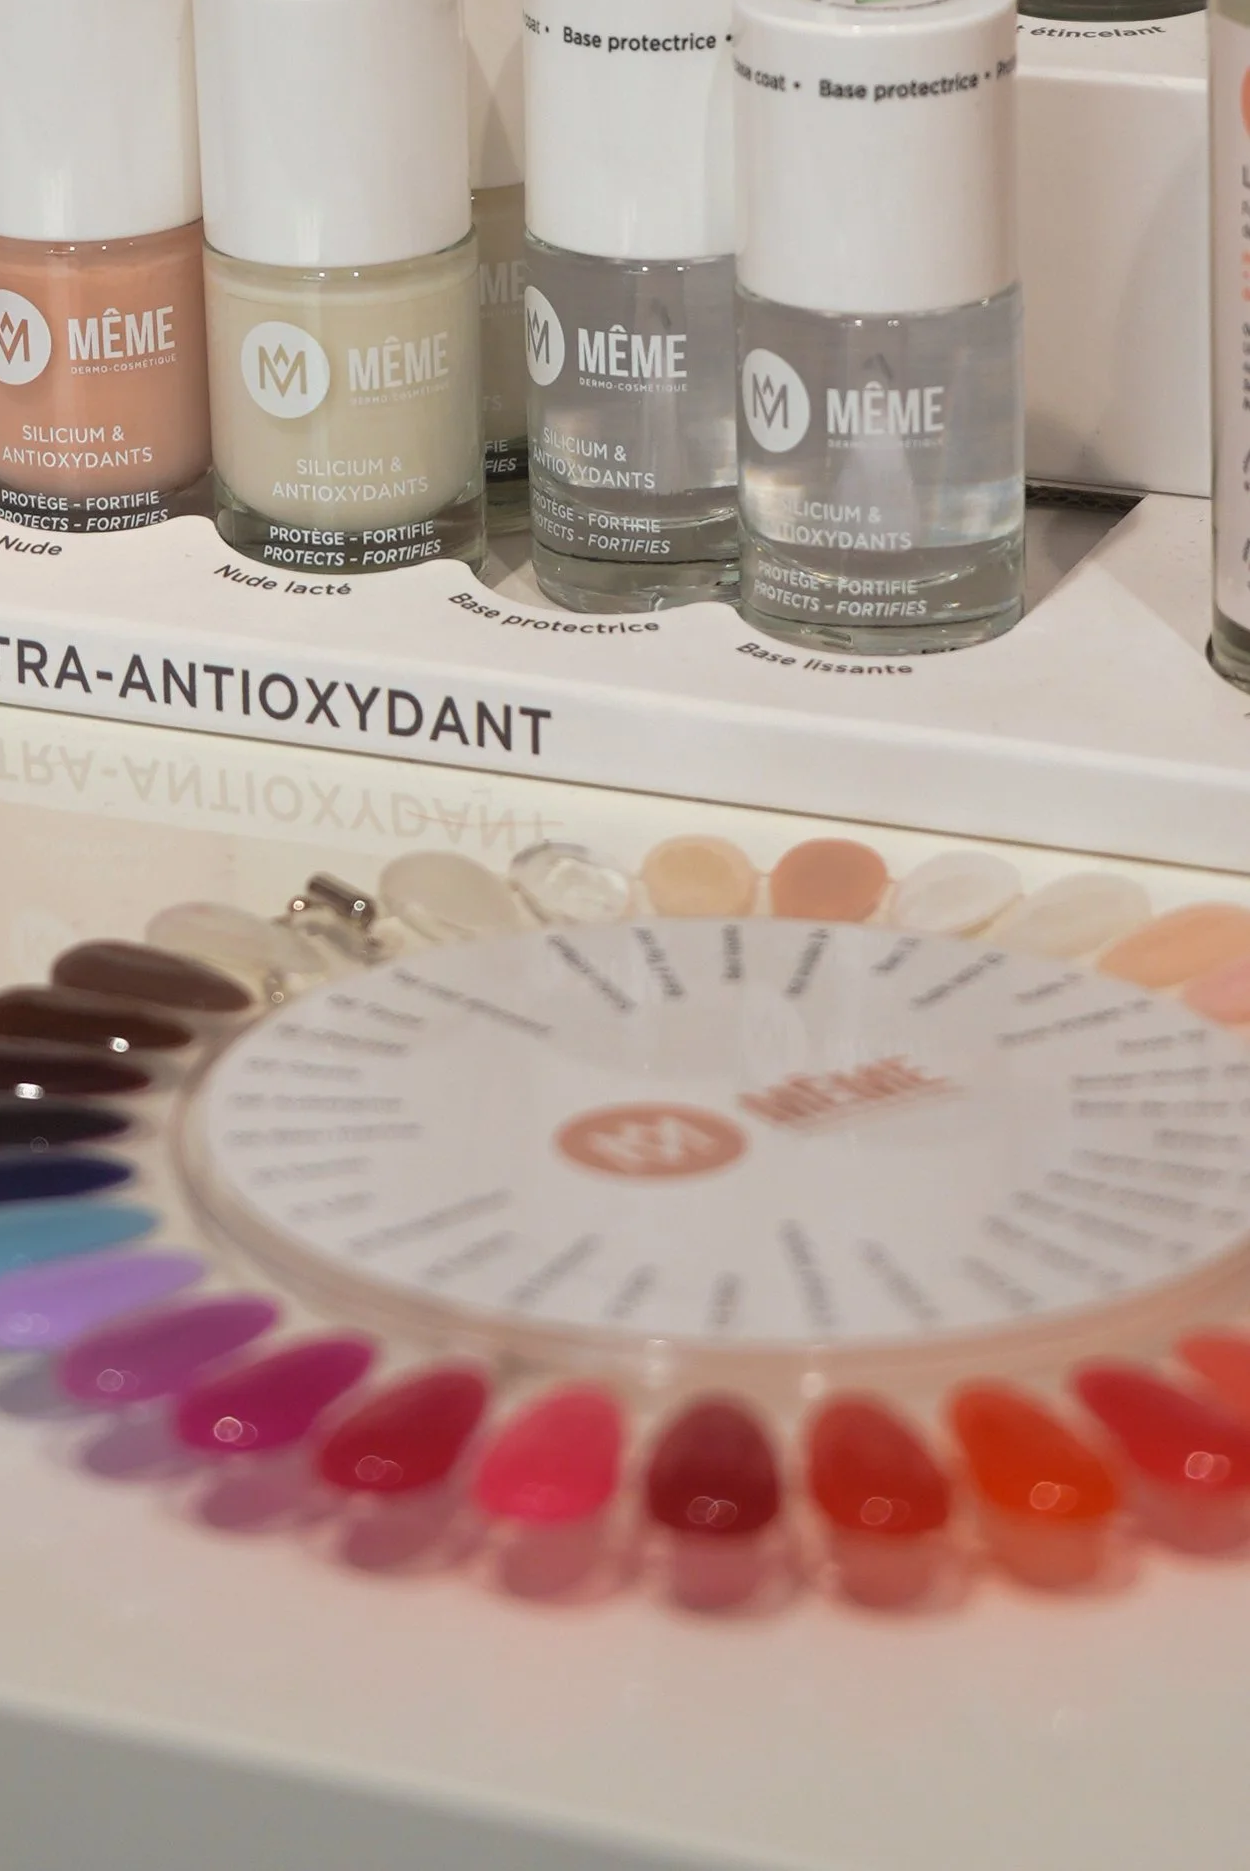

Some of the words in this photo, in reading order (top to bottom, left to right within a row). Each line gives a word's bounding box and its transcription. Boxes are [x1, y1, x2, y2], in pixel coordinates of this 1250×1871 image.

[563, 25, 603, 49] Base
[608, 31, 717, 54] protectrice
[1030, 24, 1168, 39] étincelant
[819, 79, 867, 101] Base
[874, 71, 979, 102] protectrice
[67, 305, 176, 362] MÊME
[348, 331, 449, 393] MÊME
[577, 324, 688, 379] MÊME
[826, 380, 946, 437] MÊME
[22, 425, 105, 445] SILICIUM
[112, 425, 126, 442] &
[543, 427, 608, 460] SILICIUM
[614, 445, 627, 462] &
[1, 445, 154, 470] ANTIOXYDANTS
[296, 457, 384, 477] SILICIUM
[390, 456, 403, 473] &
[532, 445, 656, 489] ANTIOXYDANTS
[1, 488, 69, 512] PROTÈGE
[86, 489, 160, 512] FORTIFIE
[271, 477, 429, 503] ANTIOXYDANTS
[85, 508, 169, 531] FORTIFIES
[588, 513, 662, 533] FORTIFIE
[867, 505, 882, 524] &
[269, 525, 345, 546] PROTÈGE
[362, 520, 435, 544] FORTIFIE
[588, 533, 671, 554] FORTIFIES
[263, 544, 346, 567] PROTECTS
[362, 539, 441, 566] FORTIFIES
[213, 563, 278, 591] Nude
[284, 580, 353, 596] lacté
[838, 575, 919, 597] FORTIFIE
[753, 579, 820, 613] PROTECTS
[836, 599, 928, 618] FORTIFIES
[448, 592, 501, 619] Base
[501, 614, 660, 635] protectrice
[735, 642, 797, 667] Base
[803, 658, 914, 676] lissante
